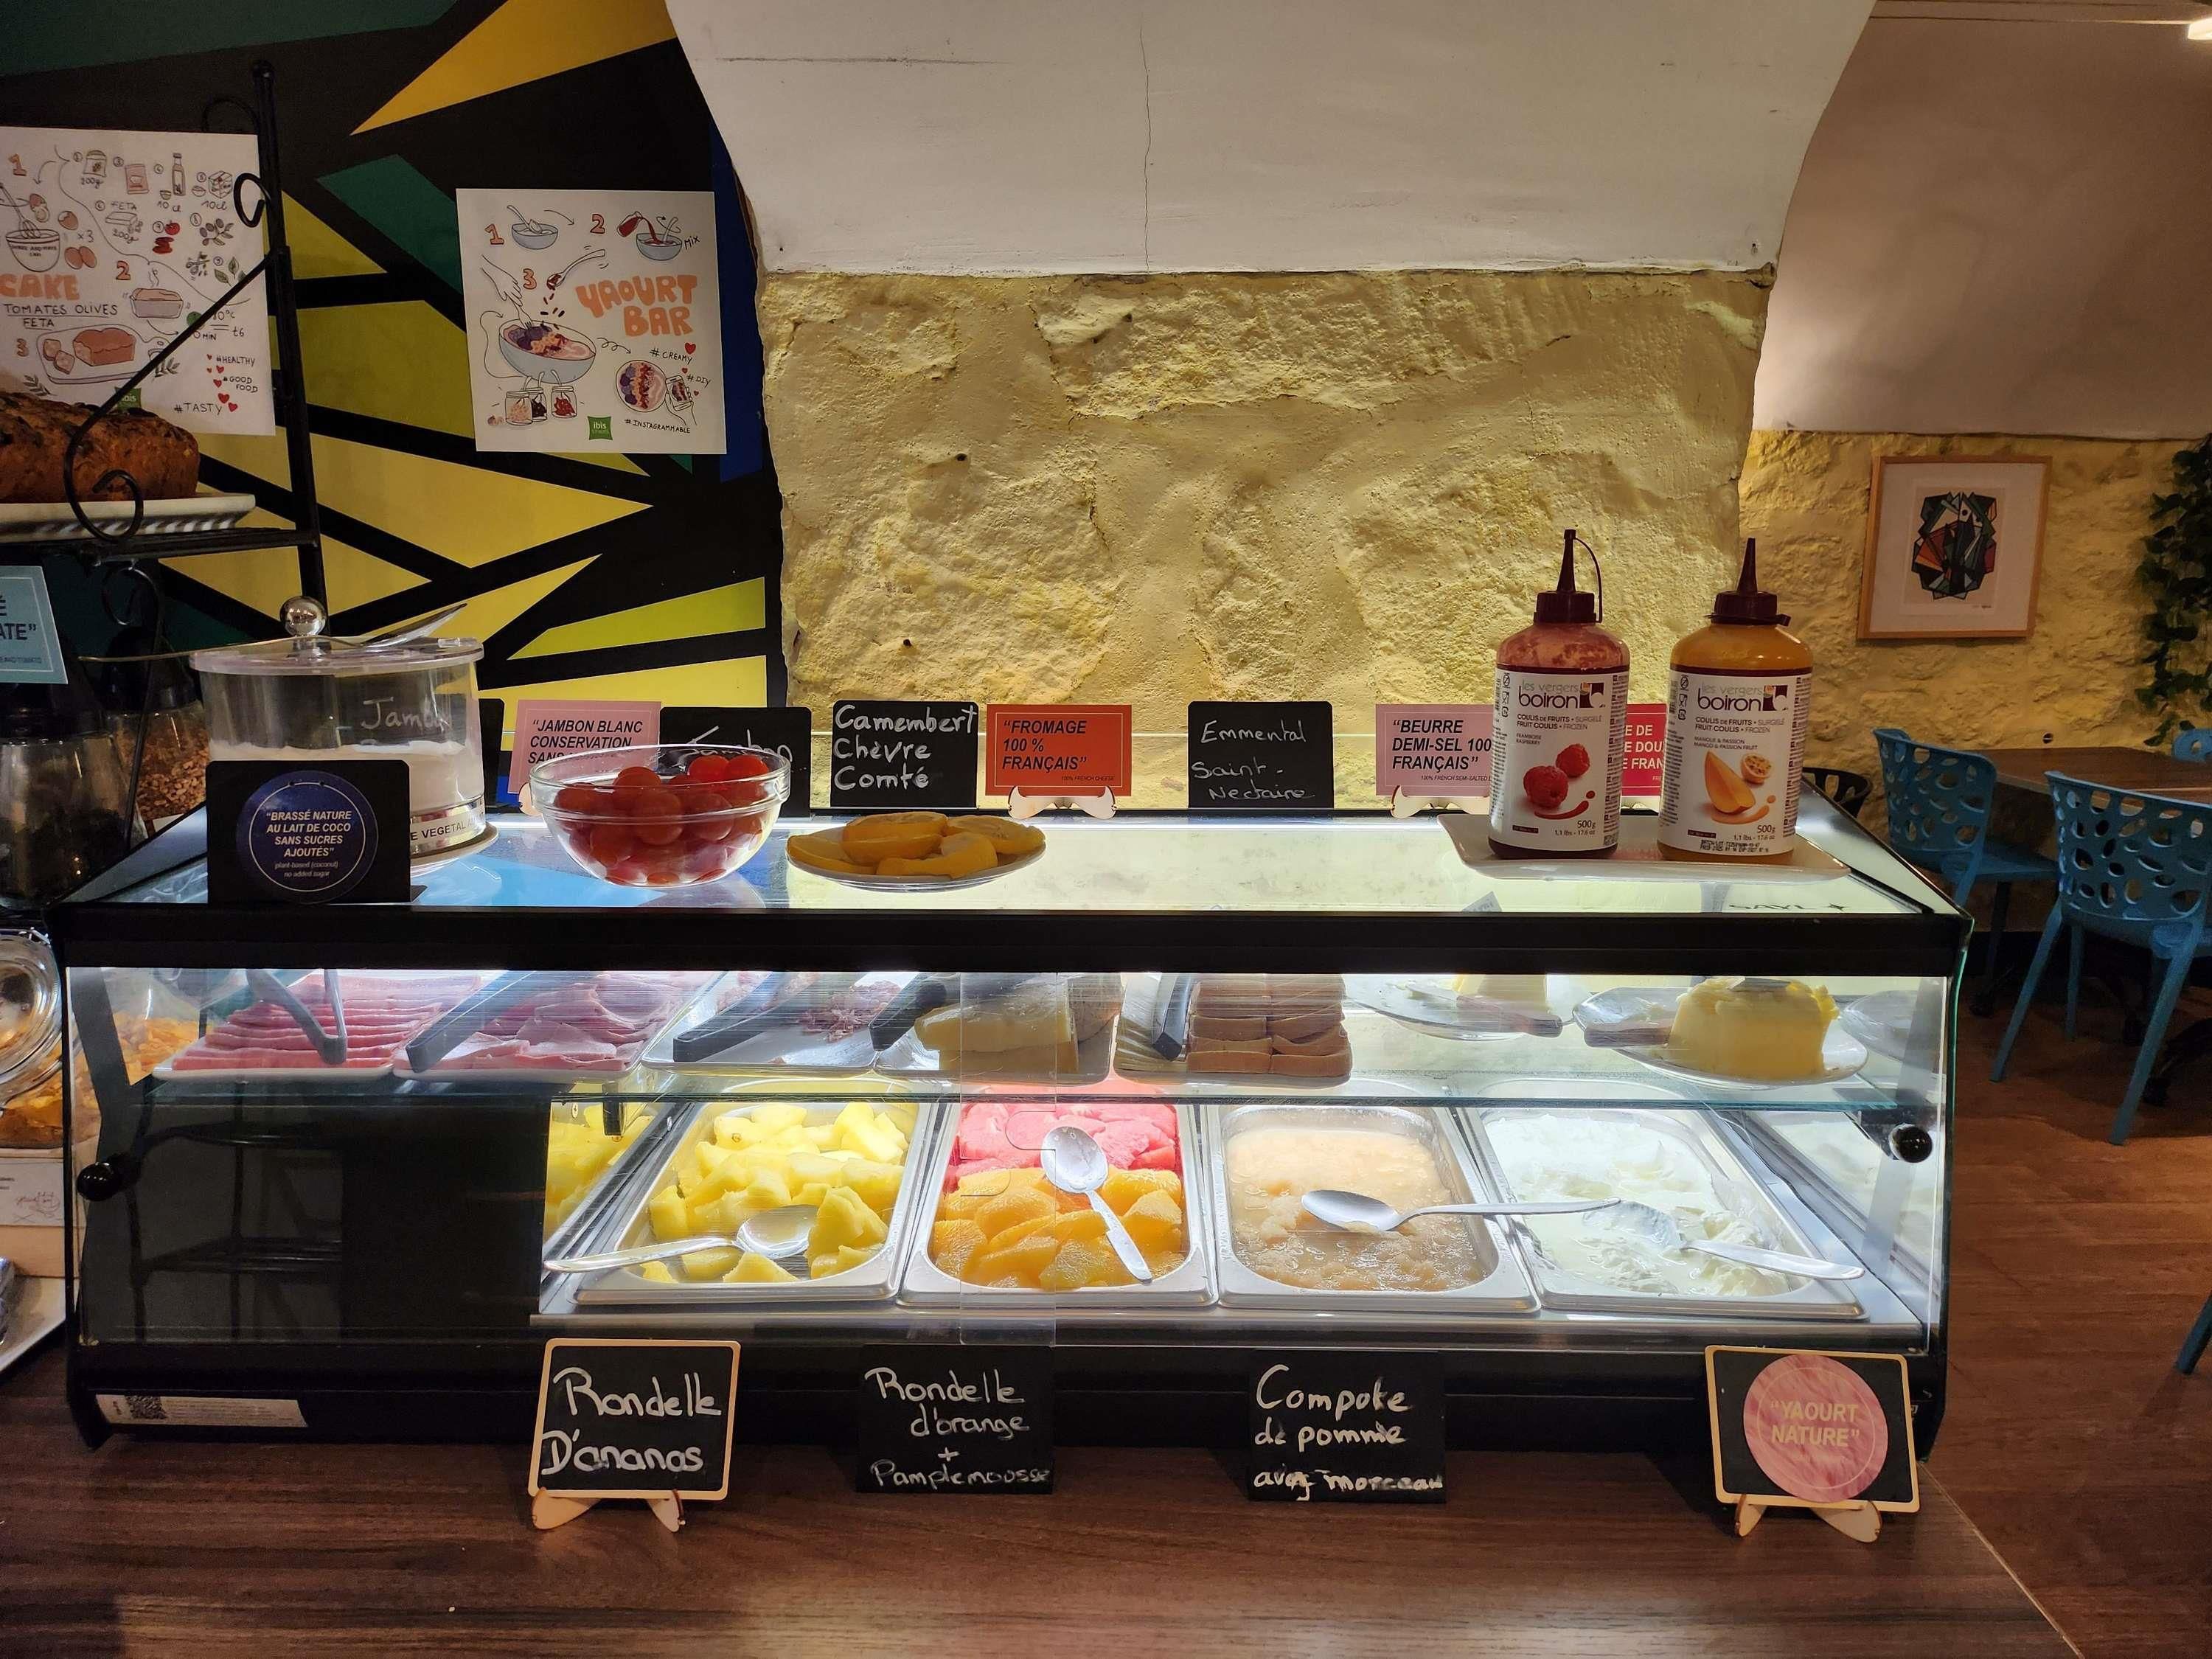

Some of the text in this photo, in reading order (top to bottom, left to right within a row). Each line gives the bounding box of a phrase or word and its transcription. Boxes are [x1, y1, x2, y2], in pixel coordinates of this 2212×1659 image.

[590, 214, 605, 234] 2
[485, 223, 504, 245] 1
[116, 260, 131, 280] 2
[523, 268, 538, 290] 3
[0, 274, 80, 301] CAKE
[575, 274, 698, 319] YAOURT
[3, 303, 67, 316] TOMATES
[24, 317, 55, 328] FETA
[624, 305, 693, 337] BAR
[16, 338, 29, 357] 3
[216, 355, 255, 368] #HEALTHY
[235, 384, 258, 393] FOOD
[174, 403, 223, 415] #TASTY
[1539, 684, 1579, 694] vergers
[1518, 685, 1578, 709] boiron
[1697, 687, 1761, 712] boiron
[597, 720, 643, 733] BLANC
[834, 705, 978, 734] Camembert
[1695, 716, 1719, 724] COULIS
[1200, 719, 1307, 743] Emmental
[1635, 724, 1653, 736] DE
[530, 735, 633, 749] CONSERVATION
[1003, 738, 1044, 753] 100 %
[1392, 737, 1492, 751] DEMI-SEL 100
[1635, 741, 1665, 753] DOU
[833, 736, 932, 764] Chèvre
[833, 762, 930, 791] Comté
[313, 810, 352, 820] NATURE
[266, 823, 351, 833] AU LAIT DE COCO
[422, 821, 466, 838] VEGETAL
[1577, 820, 1596, 830] 500g
[1757, 824, 1775, 834] 500g
[274, 835, 344, 845] SANS SUCRES
[553, 1366, 722, 1416] Rondelle
[864, 1366, 1025, 1403] Rondelle
